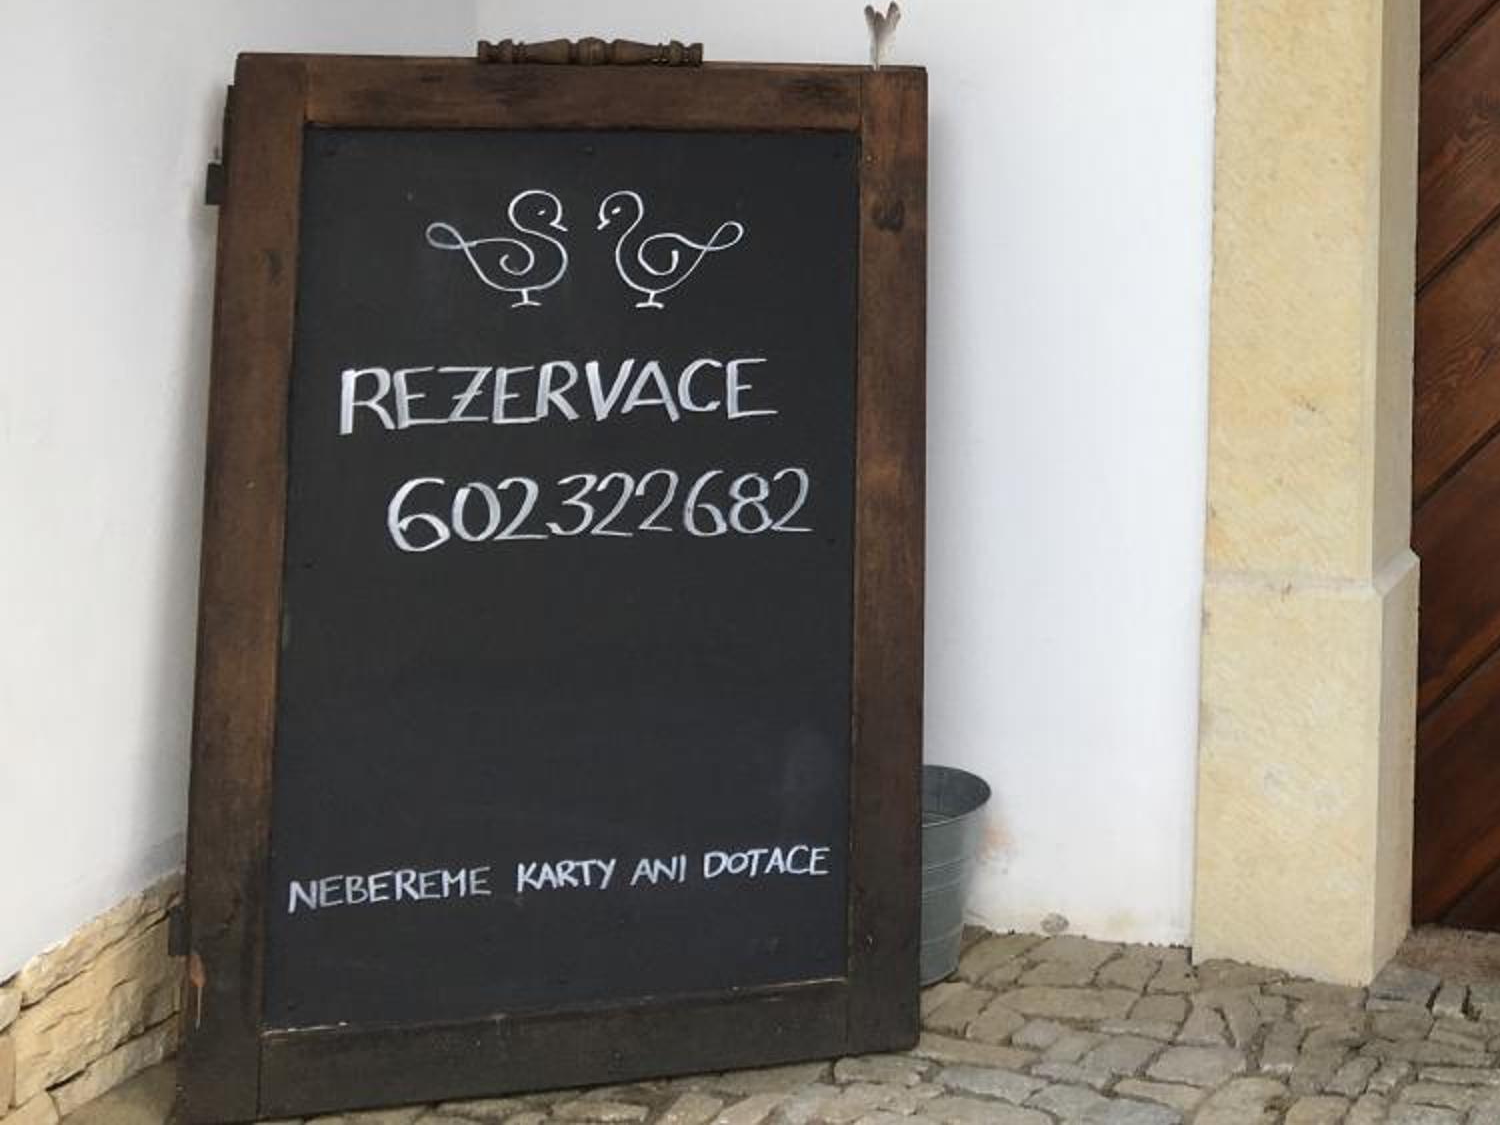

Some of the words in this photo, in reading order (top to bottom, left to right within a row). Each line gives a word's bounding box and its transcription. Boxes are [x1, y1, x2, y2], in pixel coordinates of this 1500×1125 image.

[338, 357, 779, 435] REZERVACE
[287, 866, 493, 914] NEBEREME
[516, 858, 617, 893] KARTY
[630, 854, 687, 887] ANI
[702, 844, 831, 879] DOTACE
